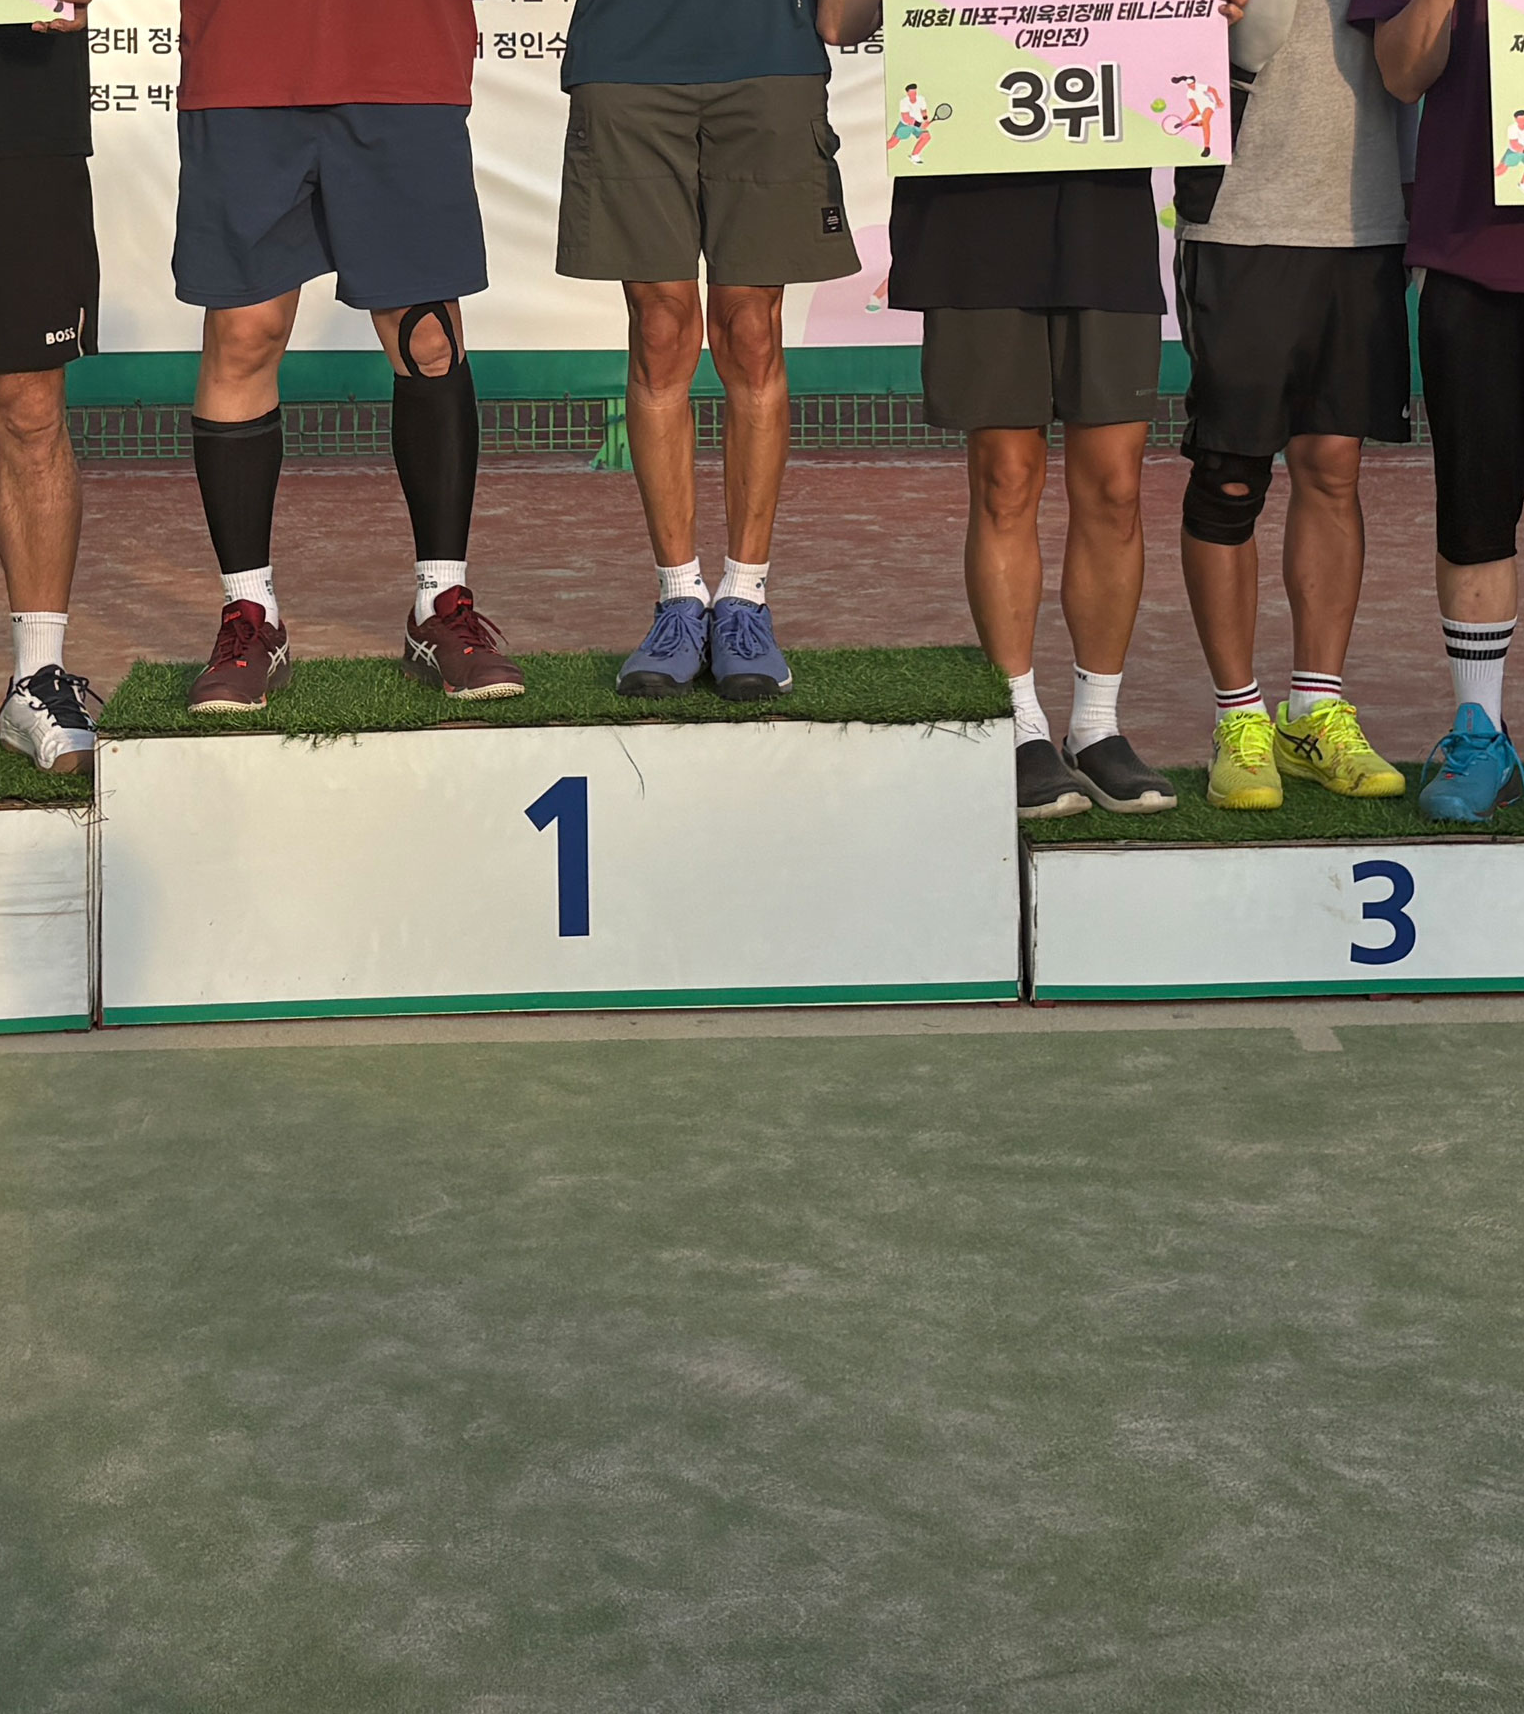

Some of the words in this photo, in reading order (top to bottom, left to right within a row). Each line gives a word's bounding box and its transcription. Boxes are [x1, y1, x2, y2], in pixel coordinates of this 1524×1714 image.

[902, 8, 955, 28] 제8회
[959, 2, 1114, 26] 마포구체육회장배
[1116, 0, 1214, 21] 테니스대회
[493, 32, 567, 59] 정인수
[1014, 27, 1089, 49] (개인전)
[998, 64, 1116, 138] 3위
[46, 327, 76, 345] BOSS
[524, 776, 590, 937] 1
[1350, 860, 1416, 965] 3
